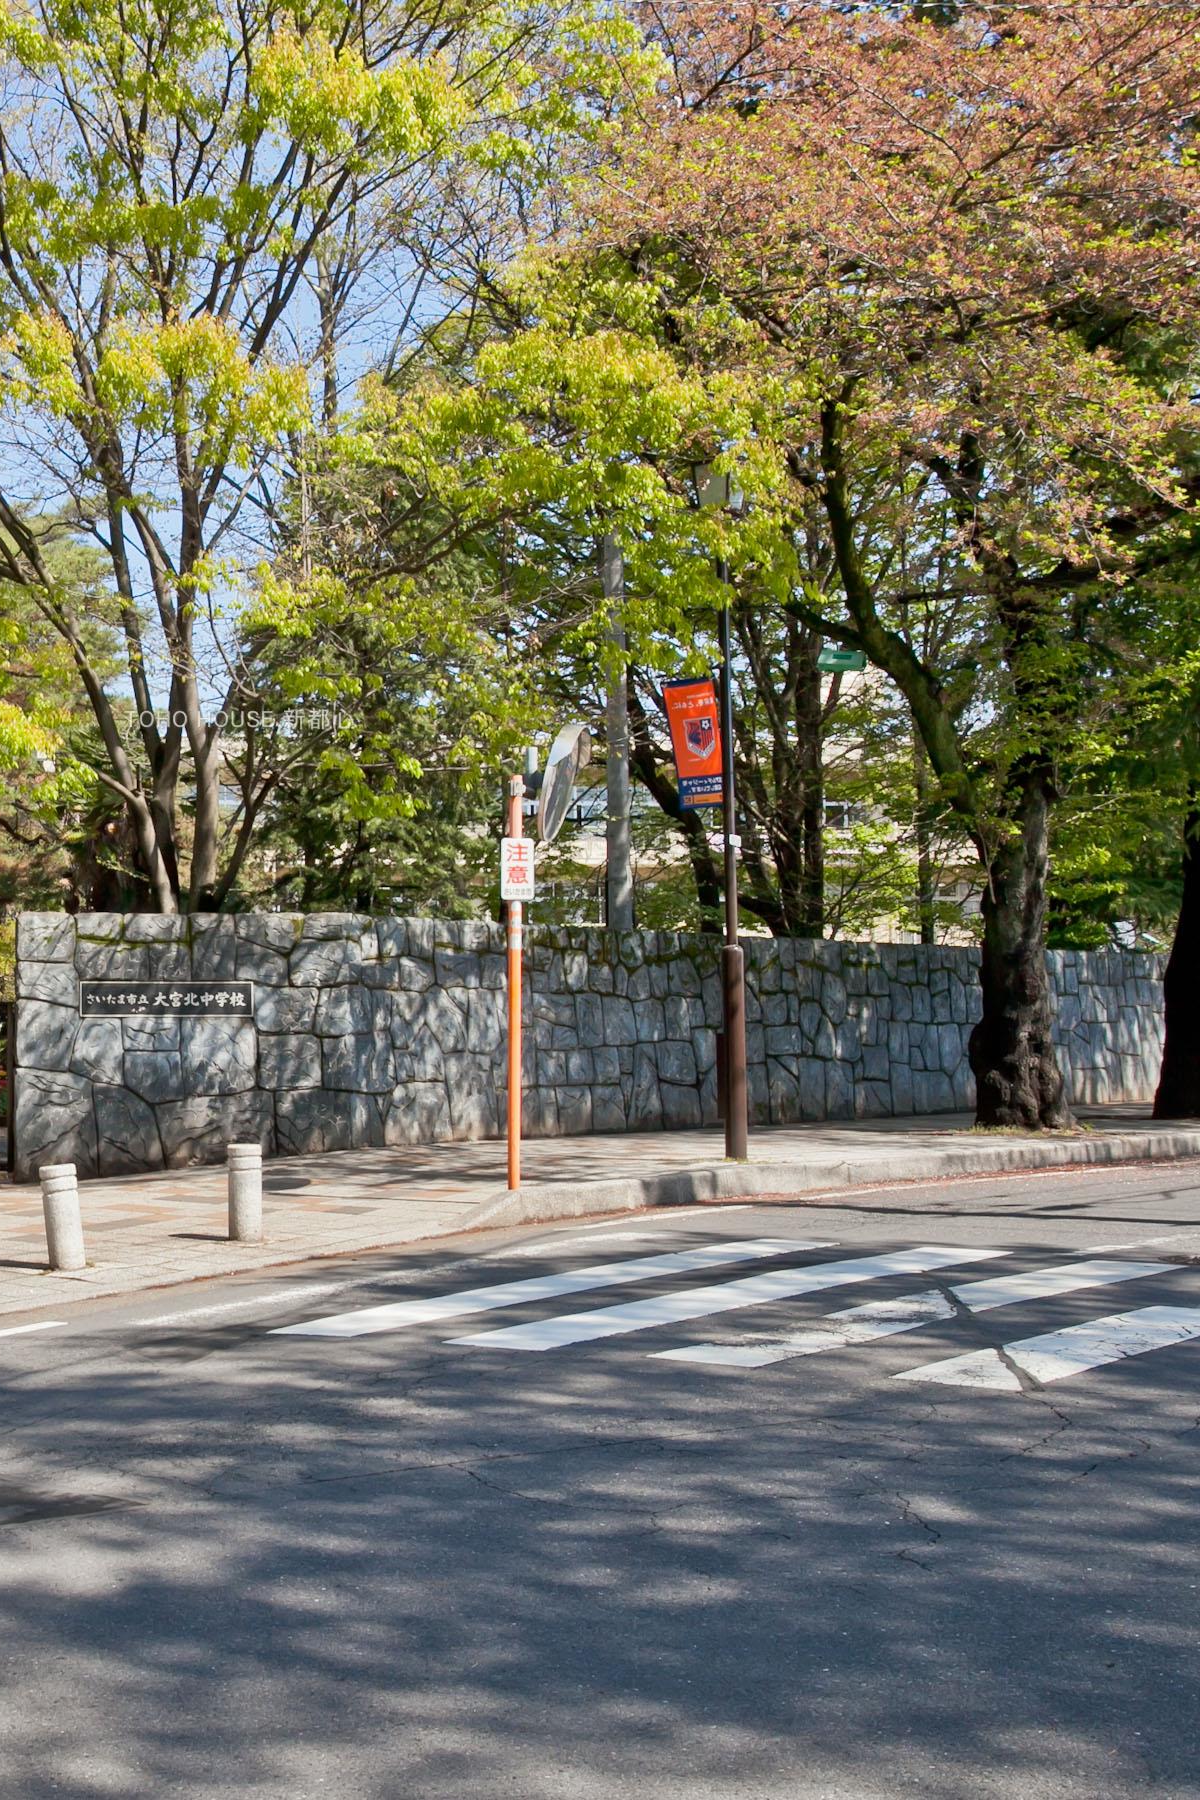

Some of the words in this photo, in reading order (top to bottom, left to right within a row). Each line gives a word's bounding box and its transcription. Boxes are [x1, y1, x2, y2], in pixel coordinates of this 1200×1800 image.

[506, 843, 529, 884] 注意
[86, 993, 149, 1005] さいたま市立
[152, 991, 247, 1008] 大宮北中学校
